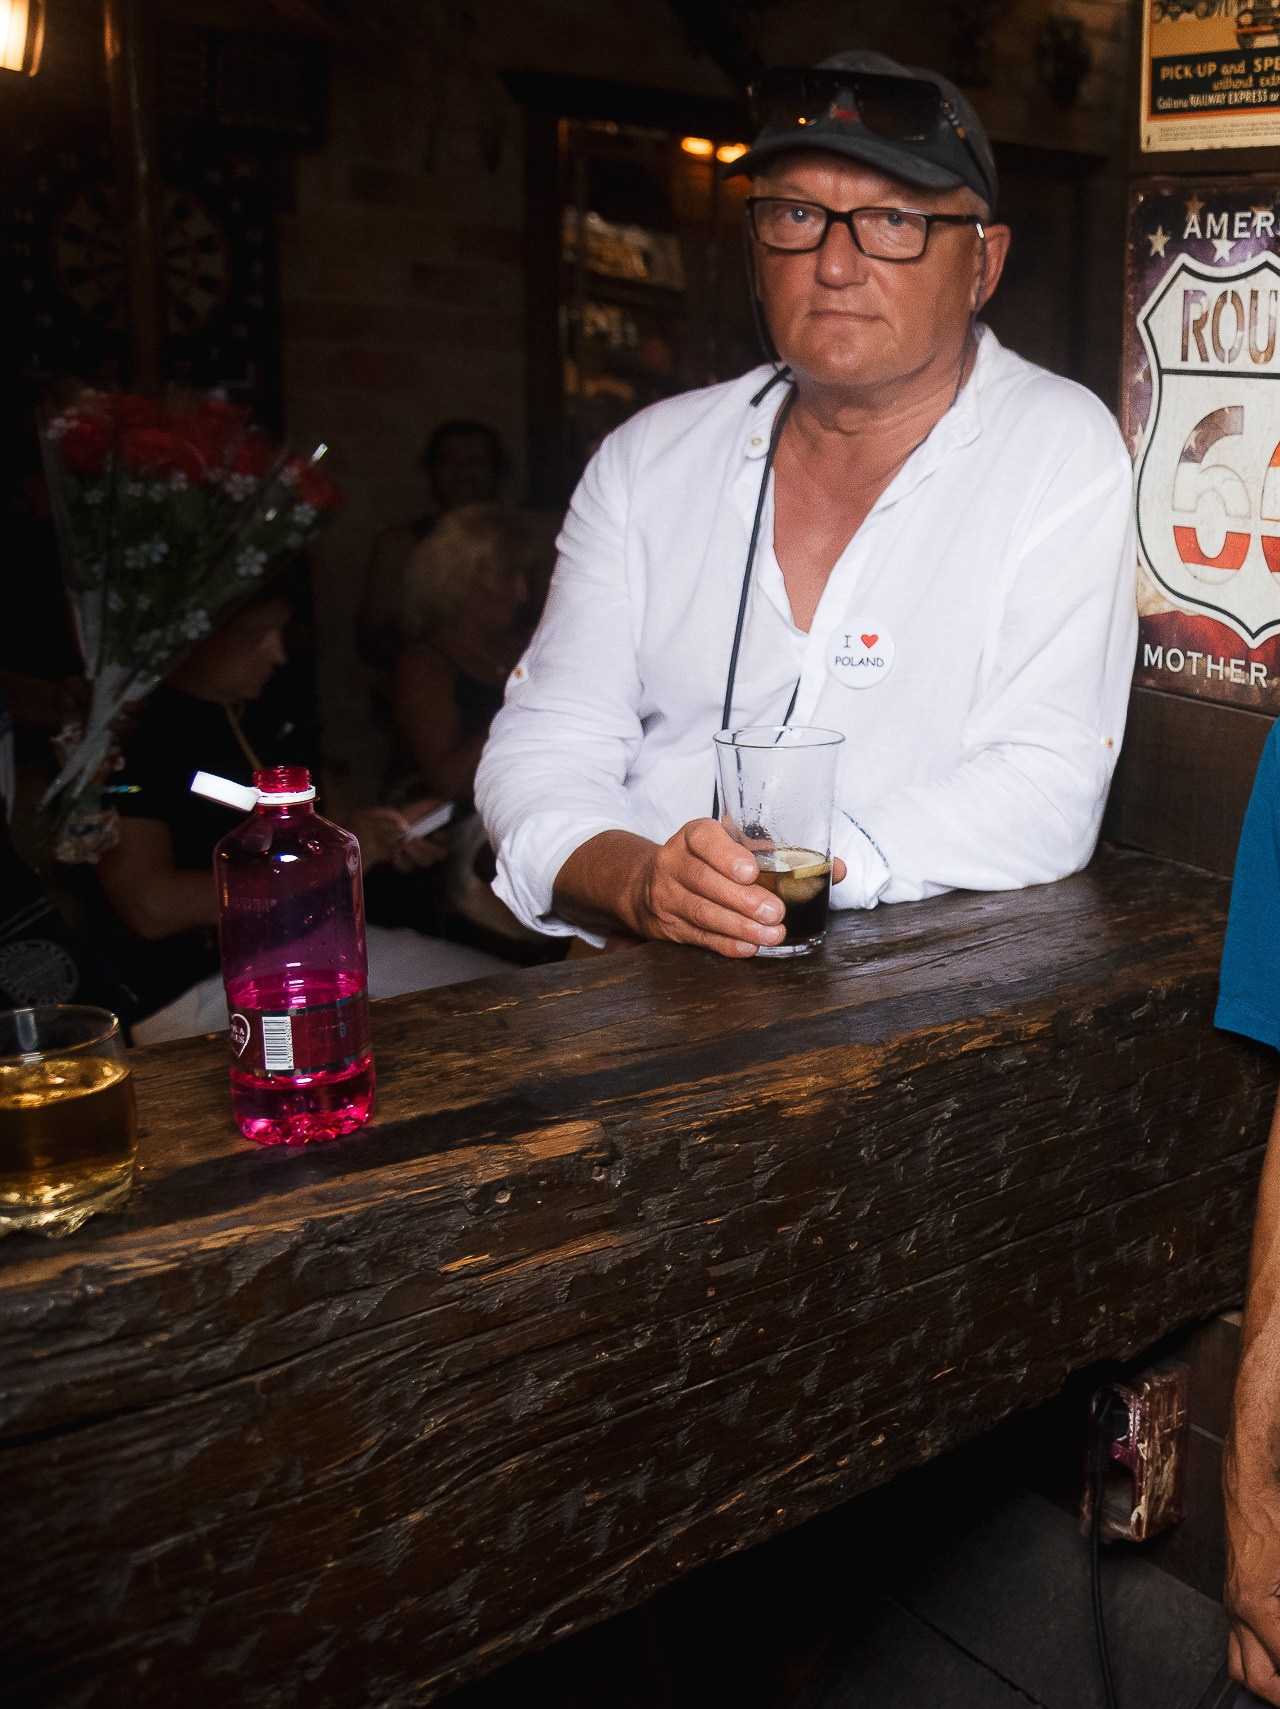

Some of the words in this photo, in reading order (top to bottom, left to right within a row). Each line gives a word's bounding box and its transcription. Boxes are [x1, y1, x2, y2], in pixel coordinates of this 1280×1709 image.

[1220, 60, 1246, 76] and
[1227, 88, 1268, 105] EXPRESS
[843, 634, 852, 649] I
[834, 655, 885, 668] POLAND
[1143, 643, 1268, 689] MOTHER
